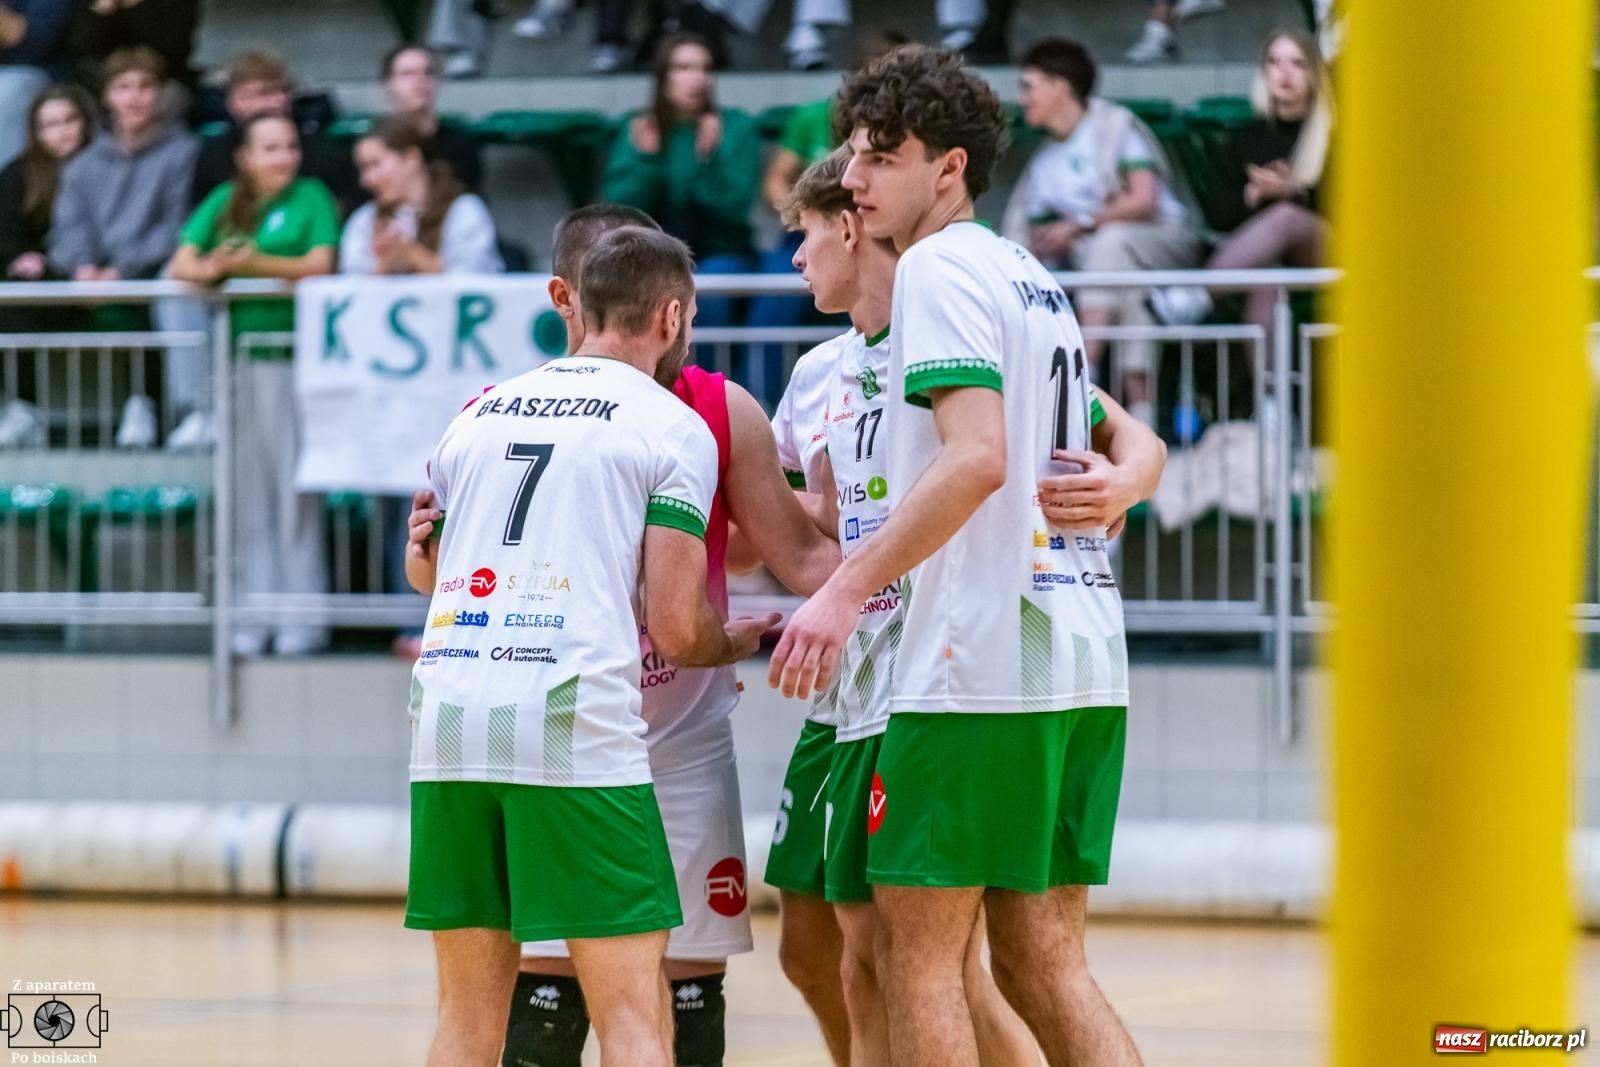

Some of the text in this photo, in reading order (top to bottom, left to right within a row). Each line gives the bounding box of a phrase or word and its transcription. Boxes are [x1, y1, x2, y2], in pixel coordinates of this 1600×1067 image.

[322, 292, 498, 379] KSR
[475, 396, 620, 422] BŁASZCZOK
[854, 407, 884, 462] 17
[502, 442, 556, 545] 7
[440, 576, 465, 594] radio
[503, 613, 565, 627] ENTECO
[421, 647, 480, 659] UBEZPIECZENIA
[513, 655, 558, 665] automatic
[515, 647, 551, 655] CONCEPT
